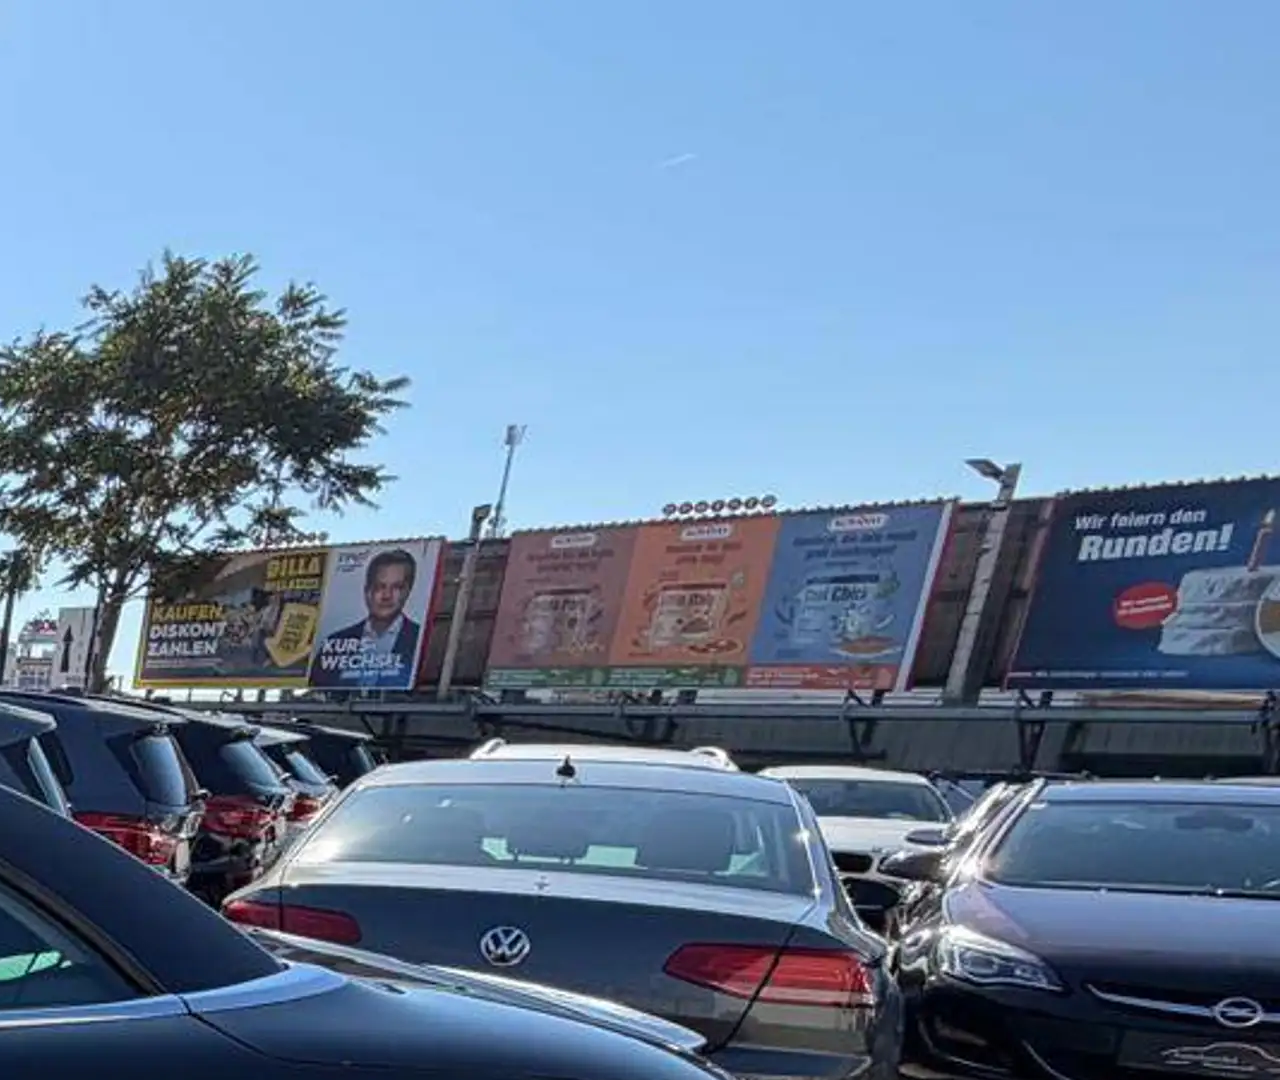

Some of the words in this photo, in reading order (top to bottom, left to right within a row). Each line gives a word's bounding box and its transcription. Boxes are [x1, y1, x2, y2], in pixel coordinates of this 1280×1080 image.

[1074, 512, 1104, 529] Wir
[1110, 511, 1166, 528] feiern
[1169, 508, 1207, 525] den
[1078, 522, 1235, 562] Runden!
[149, 621, 228, 639] DISKONT
[147, 640, 218, 657] ZAHLEN
[320, 652, 406, 670] WECHSEL
